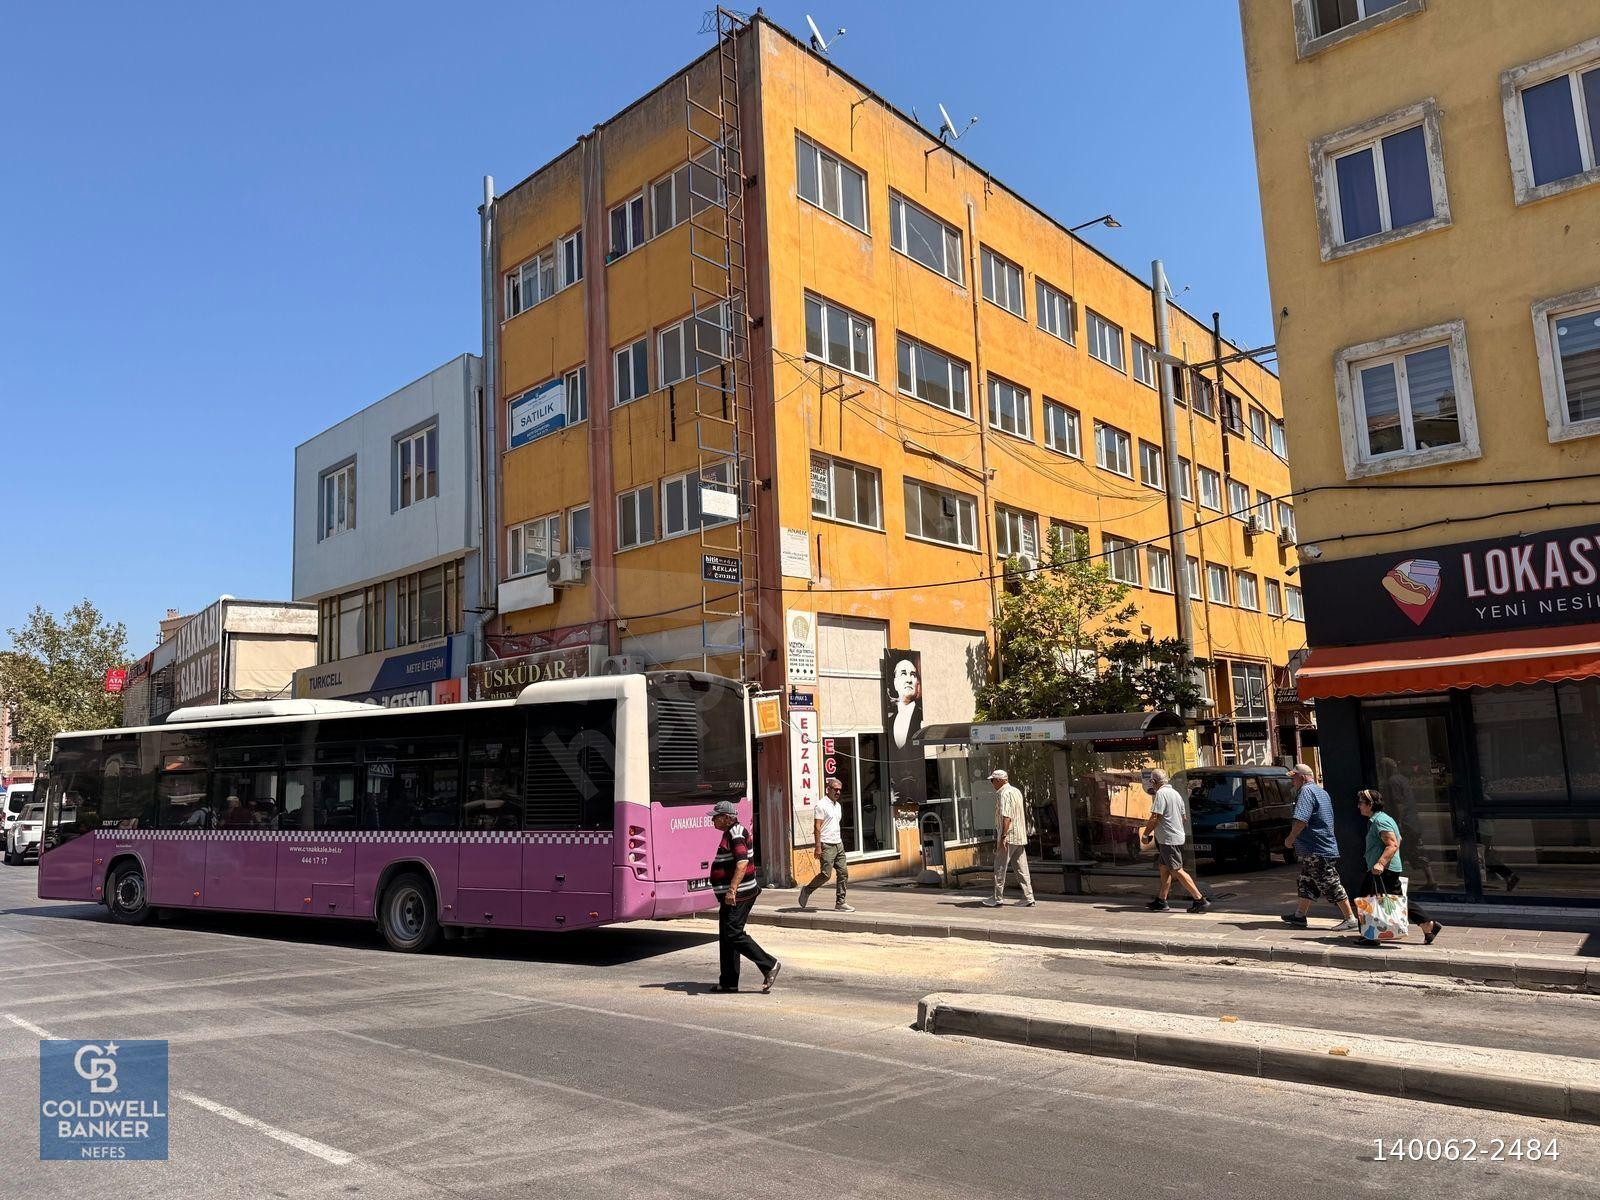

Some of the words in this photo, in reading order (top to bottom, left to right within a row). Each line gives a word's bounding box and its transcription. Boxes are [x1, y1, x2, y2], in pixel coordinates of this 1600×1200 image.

[520, 402, 554, 427] SATILIK
[1462, 536, 1600, 597] LOKAS
[1475, 600, 1527, 619] YENİ
[176, 602, 219, 665] AYAKKABI
[181, 652, 212, 703] SARAYI
[309, 672, 342, 690] TURKCELL
[406, 662, 421, 674] METE
[484, 660, 567, 689] ÜSKÜDAR
[800, 718, 812, 806] ECZANE
[671, 817, 702, 833] ÇANAKKALE
